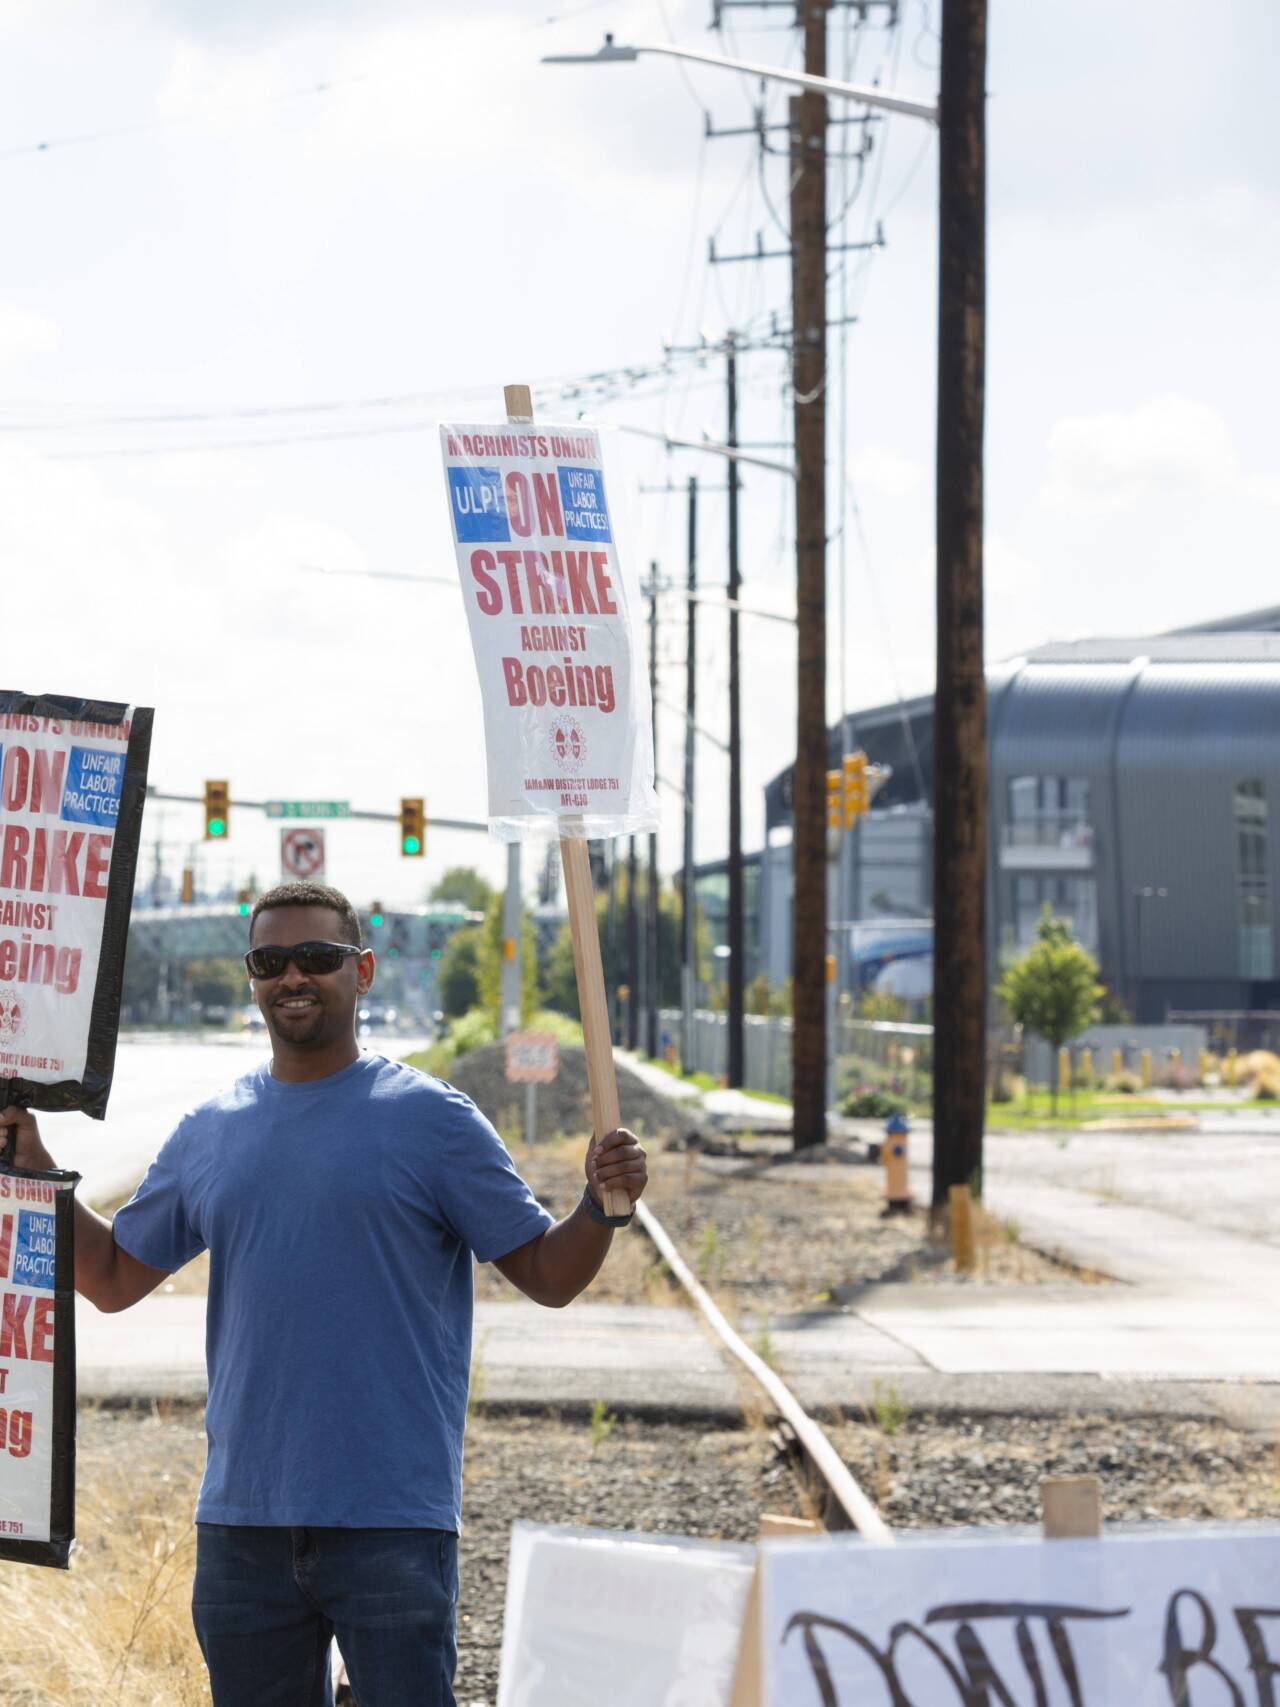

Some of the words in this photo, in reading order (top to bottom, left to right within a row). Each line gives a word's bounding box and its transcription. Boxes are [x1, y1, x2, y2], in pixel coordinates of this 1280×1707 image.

[447, 434, 549, 458] MACHINISTS
[551, 436, 597, 460] UNION
[567, 471, 597, 490] UNFAIR
[455, 486, 501, 514] ULP!
[505, 471, 565, 538] ON
[571, 490, 598, 509] LABOR
[470, 549, 618, 616] STRIKE
[521, 625, 587, 652] AGAINST
[502, 656, 616, 713] Boeing
[81, 752, 121, 775] UNFAIR
[1, 745, 66, 814] ON
[80, 772, 117, 795] LABOR
[587, 778, 608, 790] LODGE
[608, 778, 620, 790] 751
[8, 1519, 24, 1534] 751
